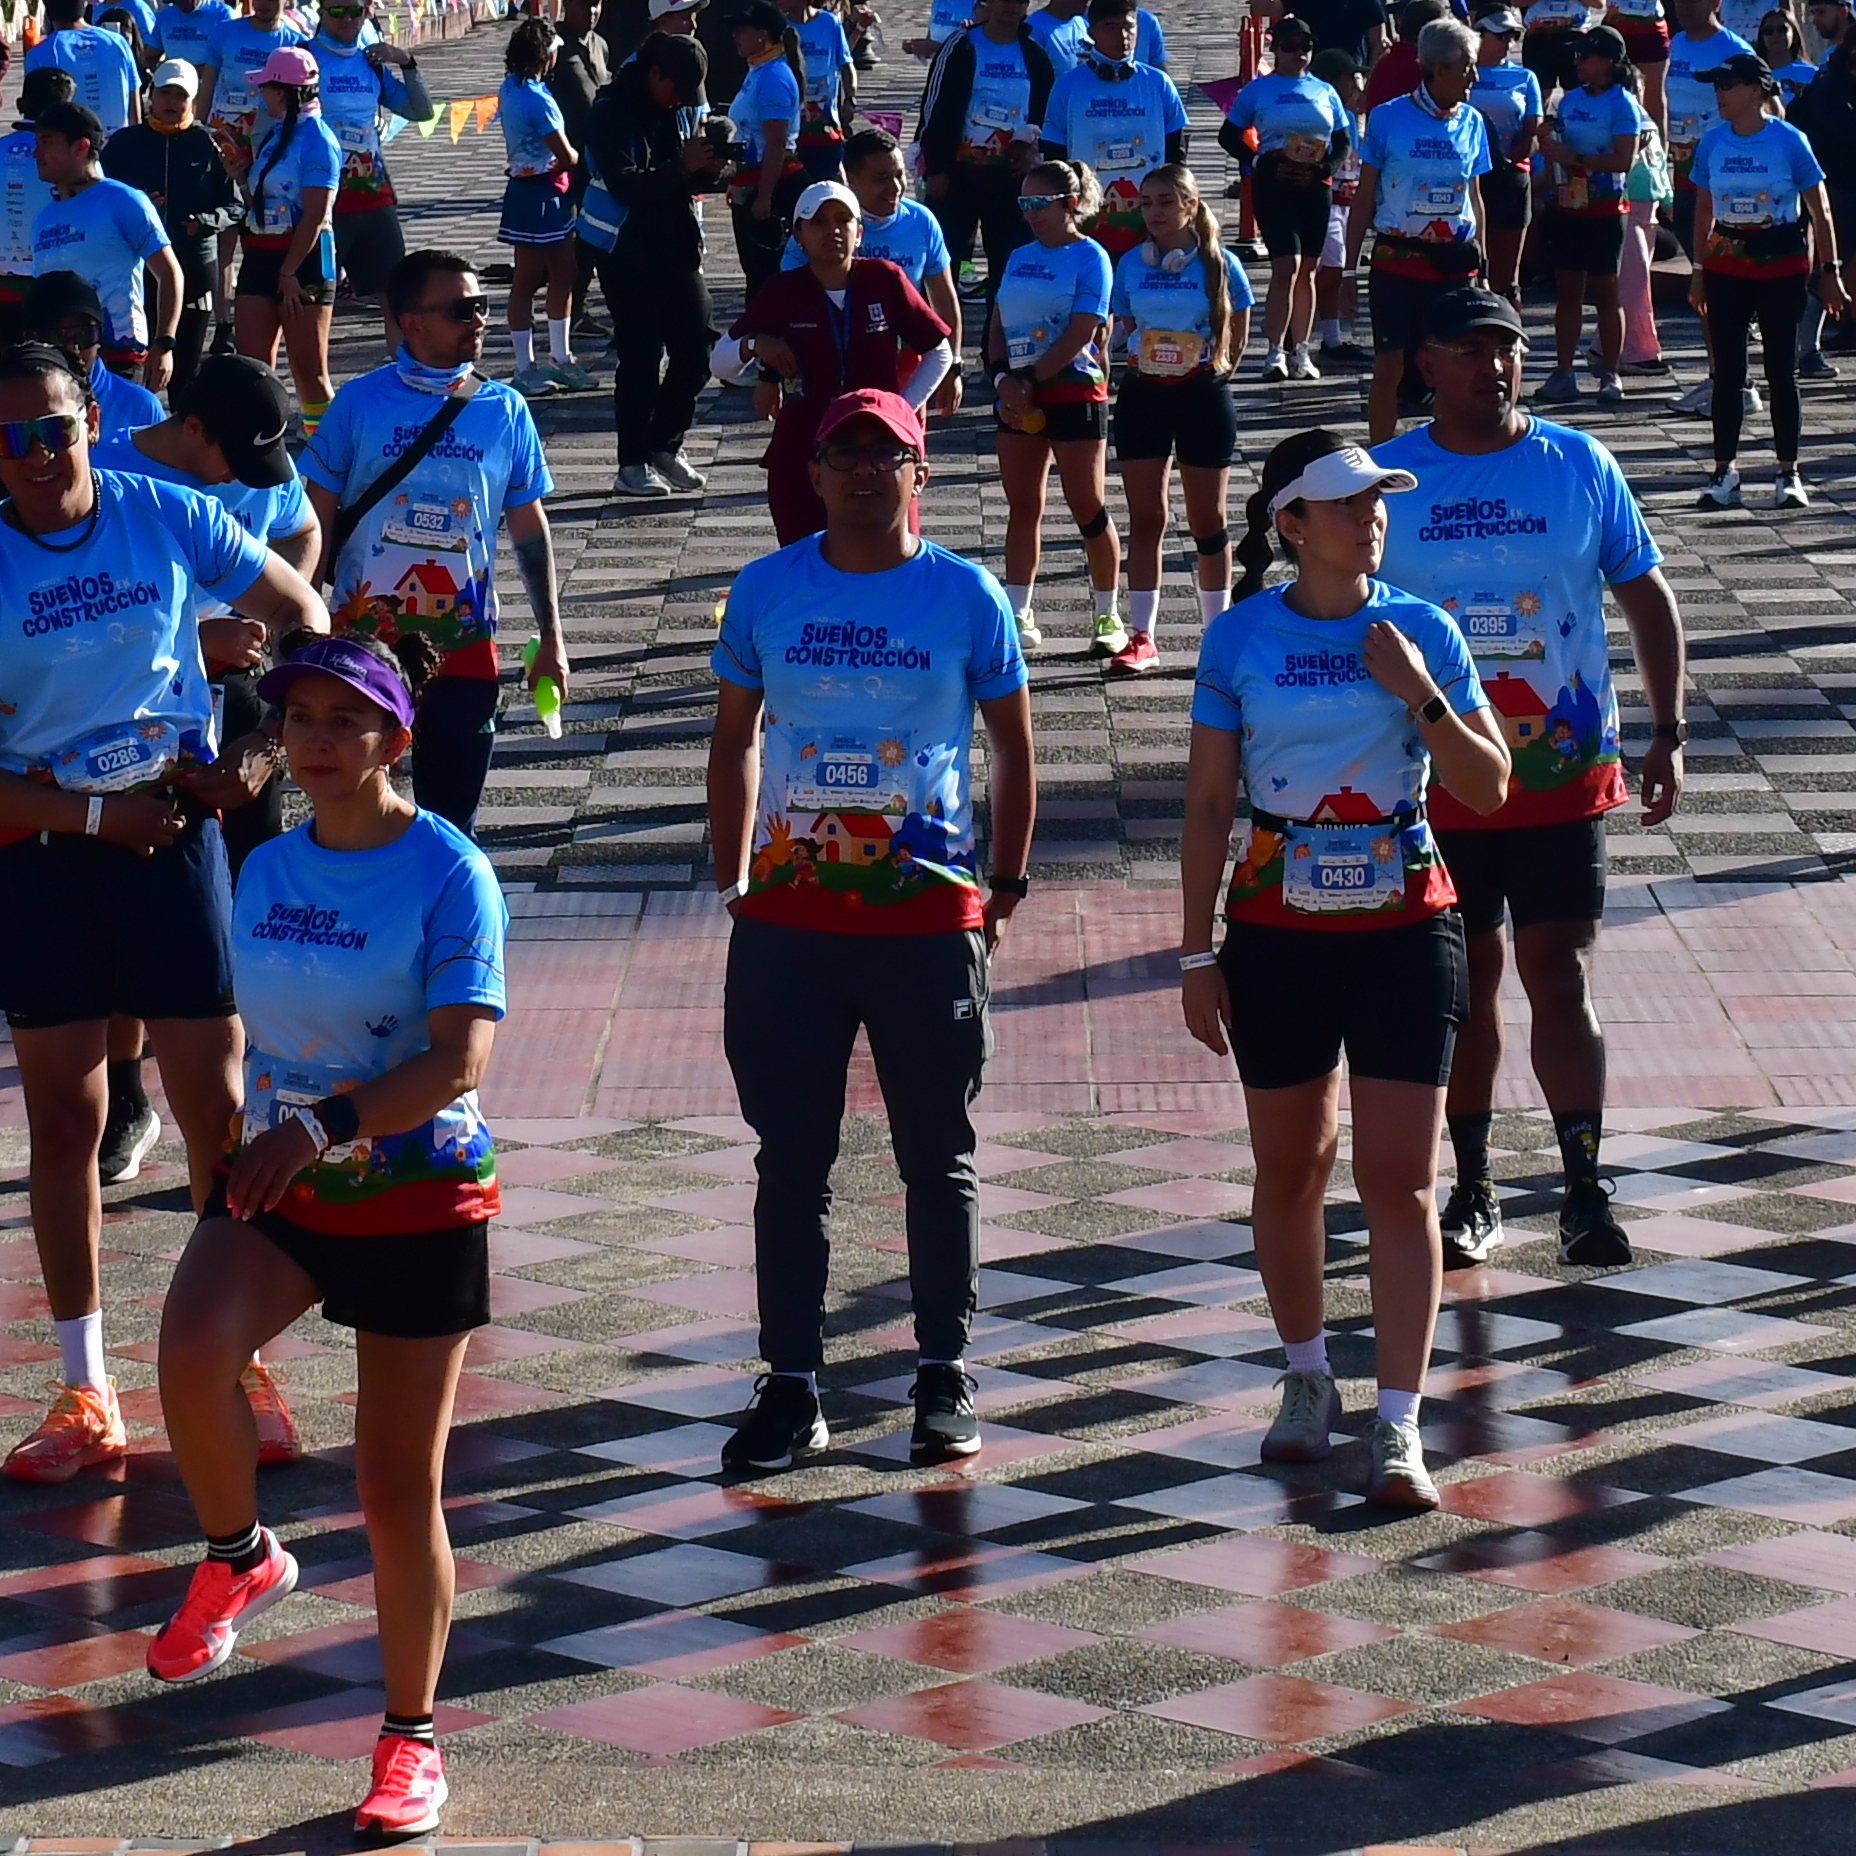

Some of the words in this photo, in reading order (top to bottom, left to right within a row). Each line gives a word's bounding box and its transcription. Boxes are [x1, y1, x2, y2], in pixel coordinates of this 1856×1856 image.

[414, 512, 444, 530] 0532
[1430, 497, 1508, 525] SUEÑOS
[1419, 514, 1548, 542] CONSTRUCCIÓN
[28, 572, 115, 616] SUEÑOS
[22, 581, 162, 638] CONSTRUCCIÓN
[801, 620, 888, 650] SUEÑOS
[1469, 616, 1507, 634] 0395
[785, 646, 932, 671] CONSTRUCCIÓN
[1285, 649, 1357, 672] SUEÑOS
[825, 764, 869, 785] 0456
[1320, 867, 1366, 887] 0430
[267, 902, 341, 932] SUEÑOS
[251, 921, 369, 952] CONSTRUCCIÓN
